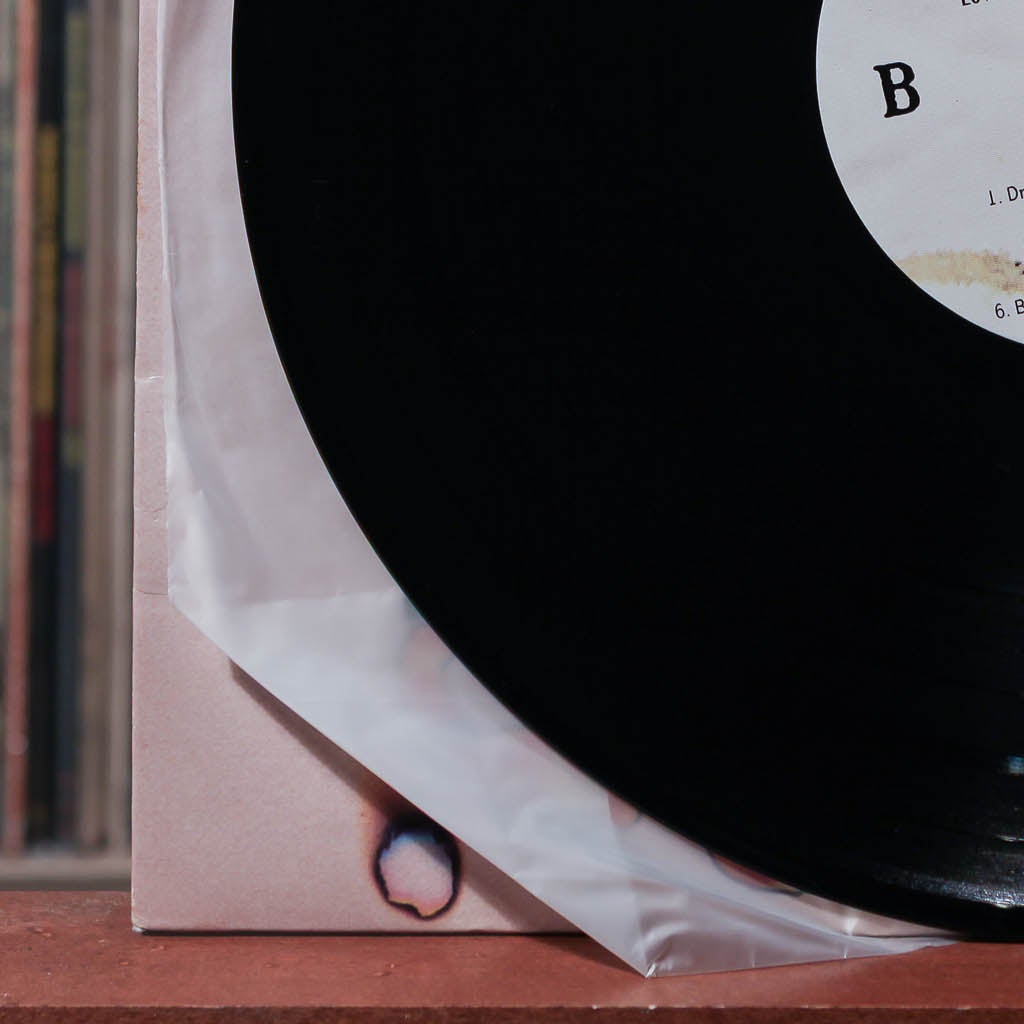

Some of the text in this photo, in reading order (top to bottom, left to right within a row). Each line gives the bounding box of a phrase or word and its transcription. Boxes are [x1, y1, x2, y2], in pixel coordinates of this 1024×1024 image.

[873, 62, 921, 118] B
[989, 190, 1003, 206] 1.
[994, 303, 1011, 319] 6.
